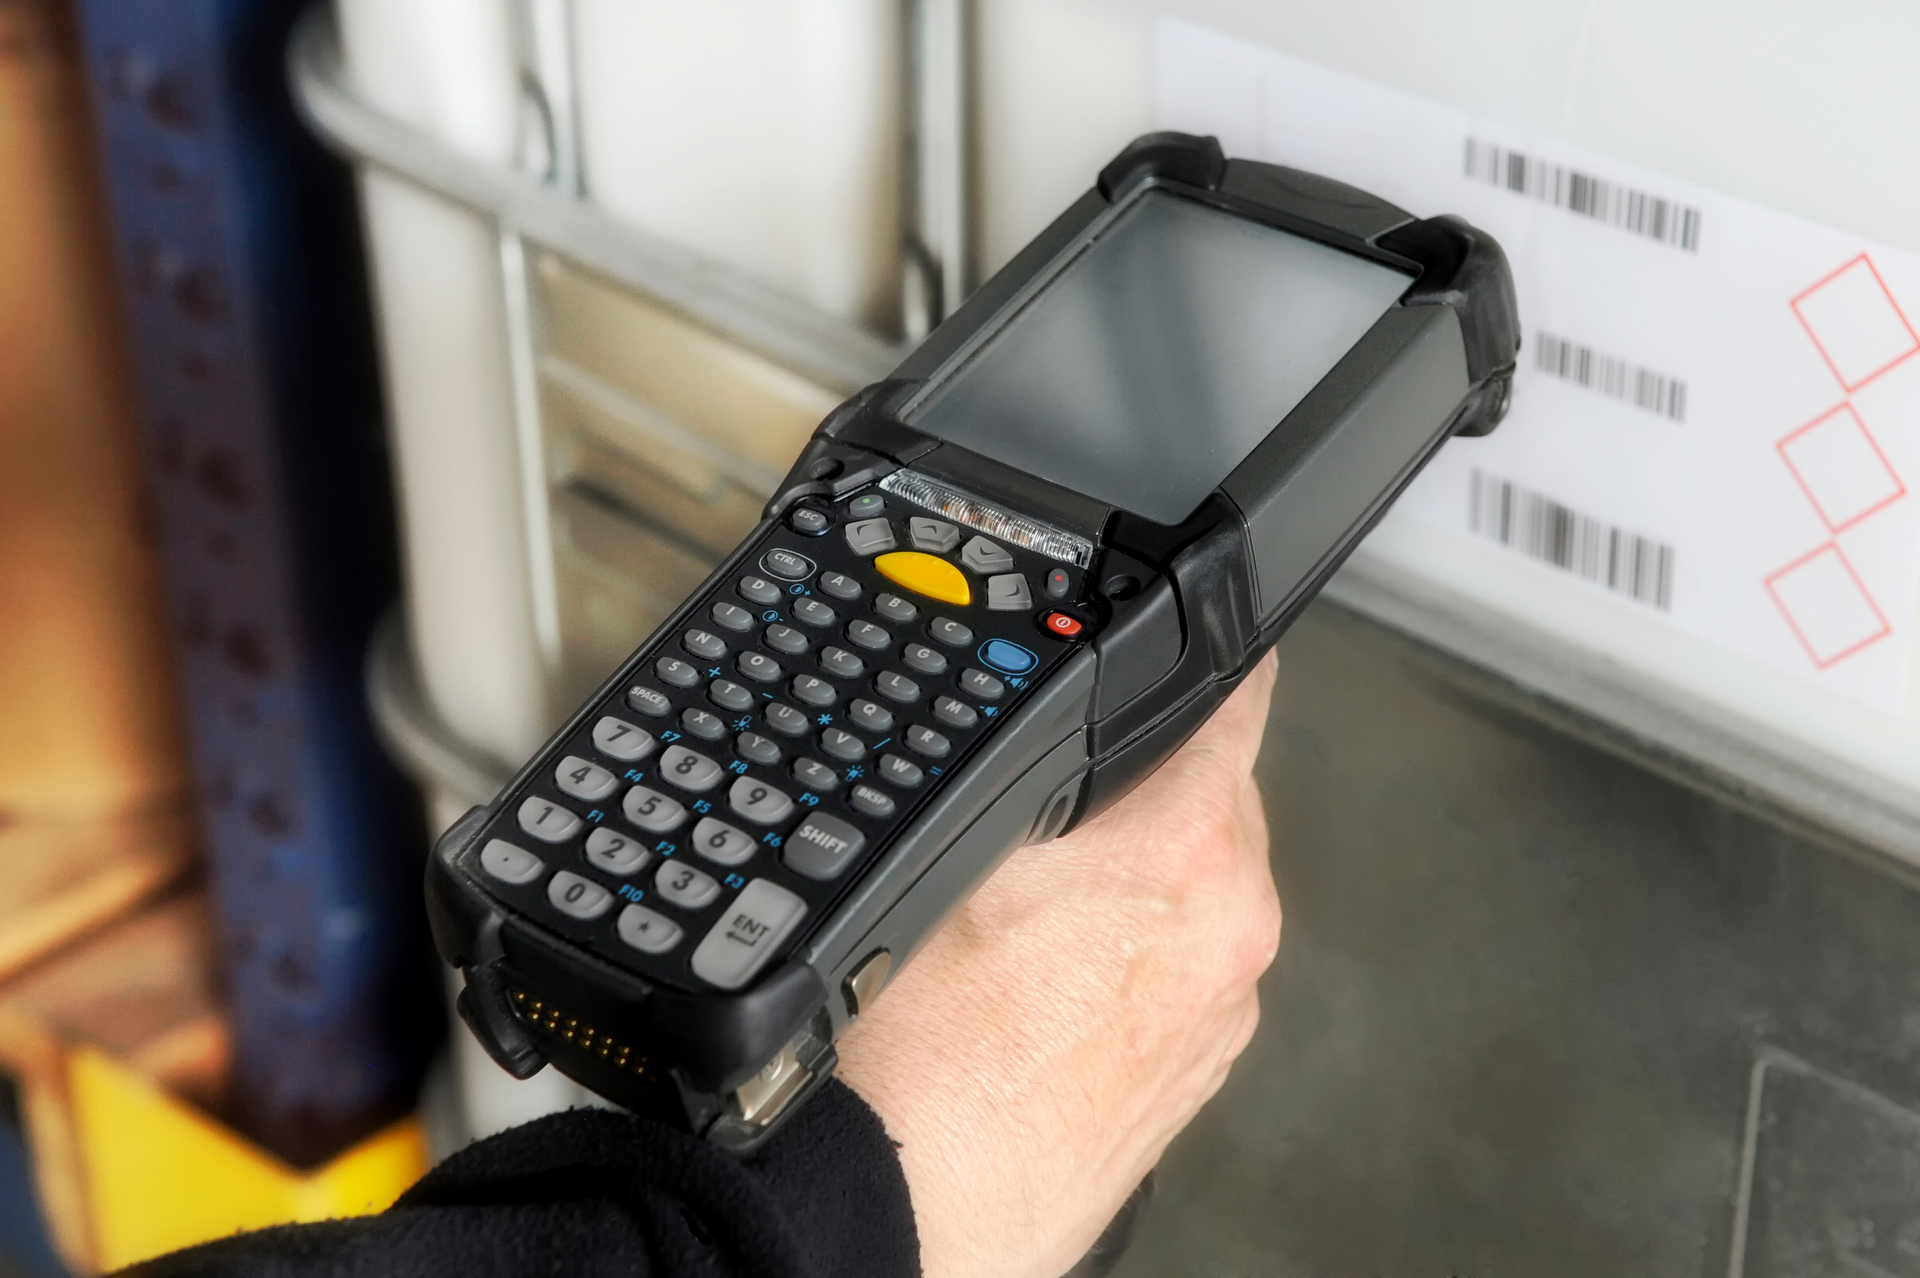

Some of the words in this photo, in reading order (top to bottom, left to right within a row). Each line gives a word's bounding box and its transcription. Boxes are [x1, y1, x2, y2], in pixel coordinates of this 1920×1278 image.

[799, 510, 818, 520] ESC
[774, 552, 796, 566] CTRL
[752, 580, 765, 590] D
[831, 576, 845, 586] A
[806, 602, 819, 612] E
[888, 598, 900, 608] B
[726, 606, 736, 615] I
[778, 628, 790, 638] J
[860, 624, 874, 633] F
[944, 622, 956, 632] C
[695, 632, 712, 644] N
[832, 651, 848, 662] K
[917, 649, 930, 659] G
[668, 662, 680, 671] S
[806, 678, 819, 688] P
[890, 676, 900, 686] L
[974, 674, 990, 685] H
[630, 686, 663, 704] SPACE
[724, 684, 736, 694] T
[778, 707, 793, 718] U
[862, 704, 876, 716] Q
[945, 701, 962, 714] M
[693, 712, 709, 723] X
[606, 724, 632, 742] 7
[660, 730, 682, 742] F7
[836, 732, 850, 744] V
[920, 730, 934, 742] R
[752, 736, 766, 748] Y
[675, 756, 698, 774] 8
[729, 760, 748, 774] F8
[806, 763, 823, 776] Z
[892, 758, 912, 773] W
[570, 766, 592, 784] 4
[624, 769, 644, 782] F4
[746, 788, 768, 806] 9
[799, 792, 820, 806] F9
[857, 787, 888, 806] BKSP
[638, 796, 662, 816] 5
[692, 800, 712, 814] F5
[536, 806, 554, 826] 1
[586, 810, 604, 823] F1
[708, 830, 731, 848] 6
[763, 832, 782, 847] F6
[799, 824, 848, 854] SHIFT
[600, 838, 625, 860] 2
[656, 840, 676, 856] F2
[672, 870, 695, 891] 3
[724, 873, 745, 889] F3
[618, 884, 644, 902] F10
[732, 914, 770, 939] ENT
